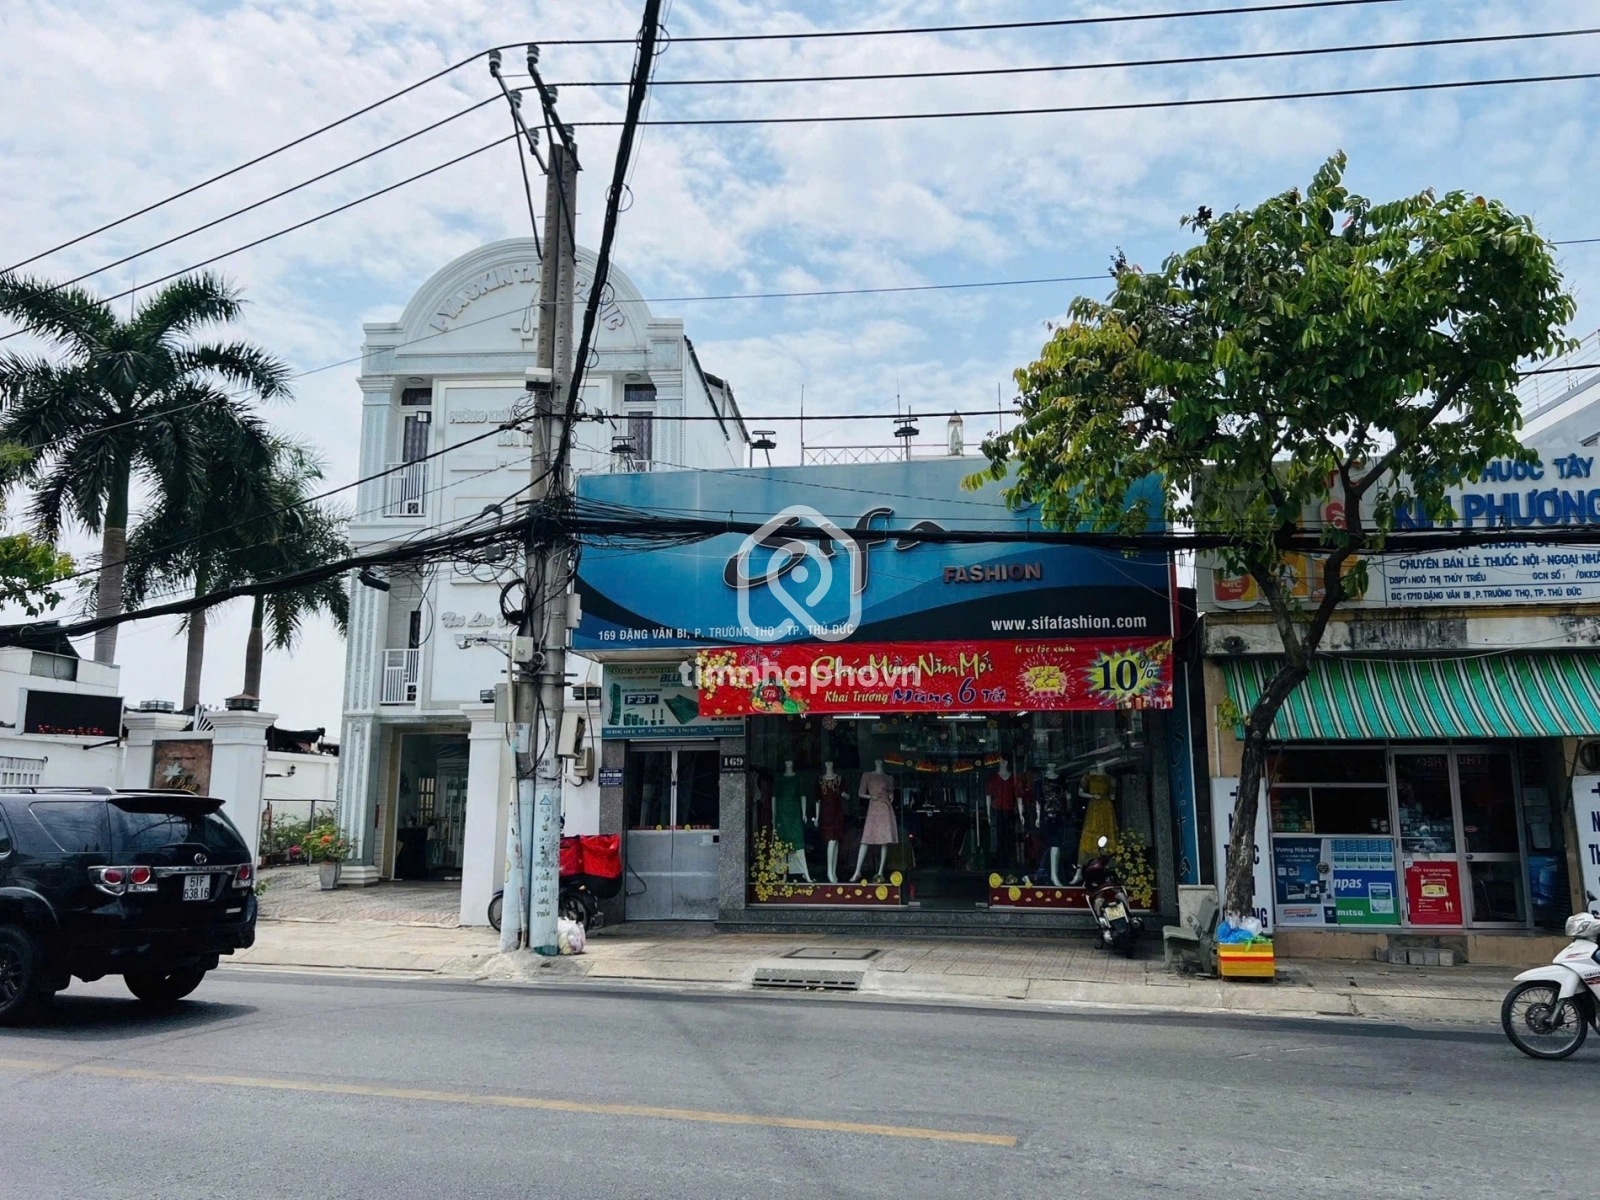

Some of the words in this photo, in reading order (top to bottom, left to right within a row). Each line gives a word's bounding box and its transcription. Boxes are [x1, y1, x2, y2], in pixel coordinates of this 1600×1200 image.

[1553, 453, 1594, 479] TÂY
[1443, 554, 1464, 568] BÁN
[943, 562, 1042, 583] FASHION
[991, 615, 1147, 631] www.sifafashion.com
[598, 630, 617, 641] 169
[619, 629, 649, 643] ĐẶNG
[652, 627, 672, 639] VĂN
[677, 628, 691, 640] BI,
[694, 628, 705, 639] P.
[709, 625, 751, 639] TRƯỜNG
[755, 626, 775, 639] THỌ
[807, 621, 828, 636] THỦ
[824, 690, 849, 703] Khai
[958, 677, 977, 704] 6
[626, 695, 657, 705] FBT
[723, 757, 744, 766] 169
[189, 876, 205, 888] 51F
[183, 888, 209, 900] 638.16
